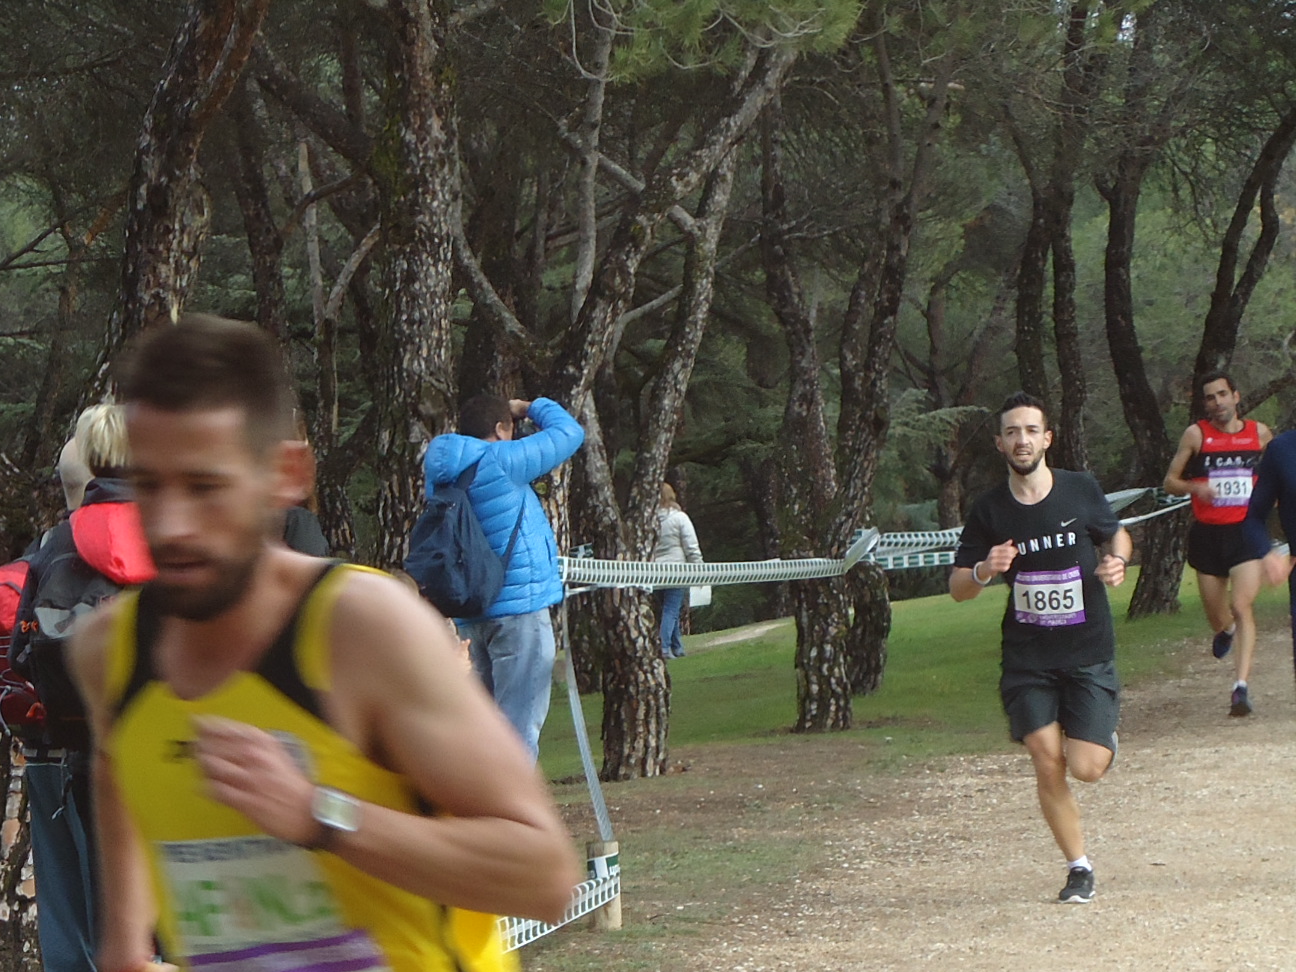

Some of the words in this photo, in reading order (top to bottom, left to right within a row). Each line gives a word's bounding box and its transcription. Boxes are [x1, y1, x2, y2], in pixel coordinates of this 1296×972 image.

[1215, 481, 1247, 496] 1931
[1017, 531, 1077, 556] UNNER
[1022, 588, 1074, 611] 1865
